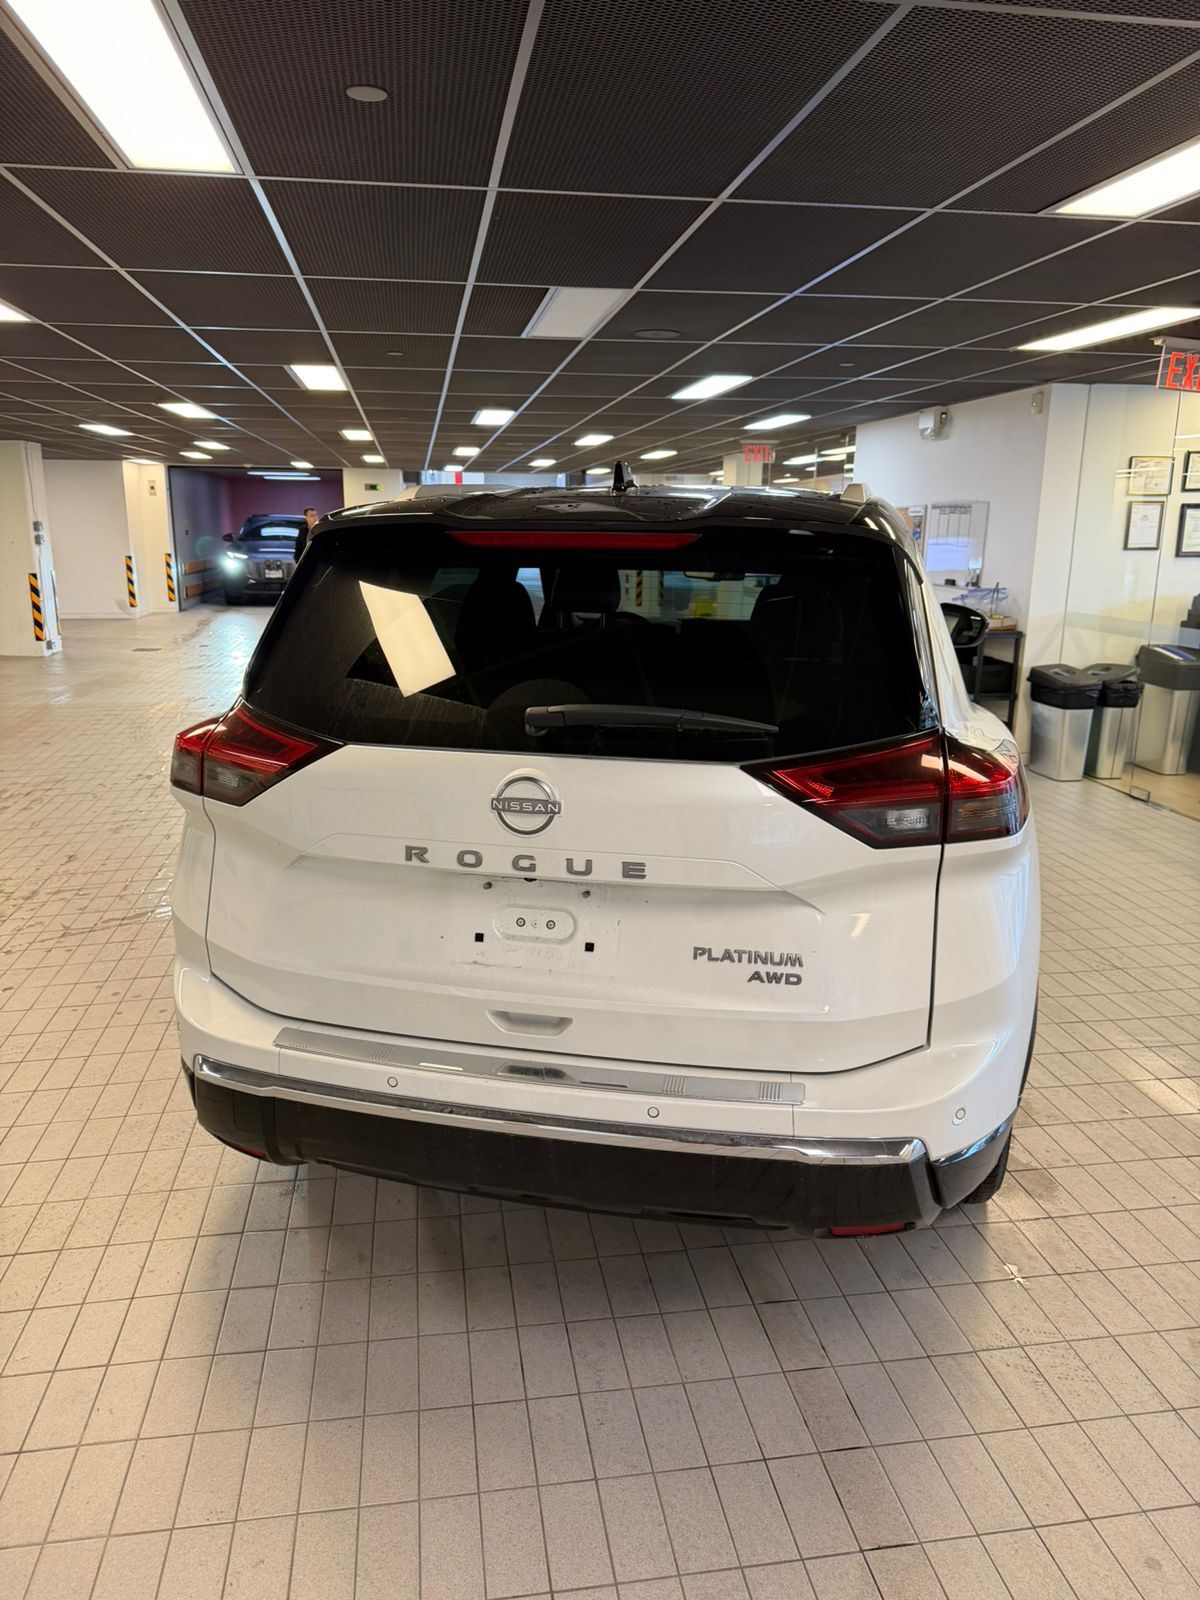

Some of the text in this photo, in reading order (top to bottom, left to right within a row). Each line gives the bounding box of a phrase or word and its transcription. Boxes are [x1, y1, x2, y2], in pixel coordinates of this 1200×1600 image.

[742, 444, 769, 463] EXIT
[493, 800, 559, 812] NISSAN
[404, 845, 647, 879] ROGUE
[693, 946, 804, 968] PLATINUM
[746, 970, 803, 986] AWD
